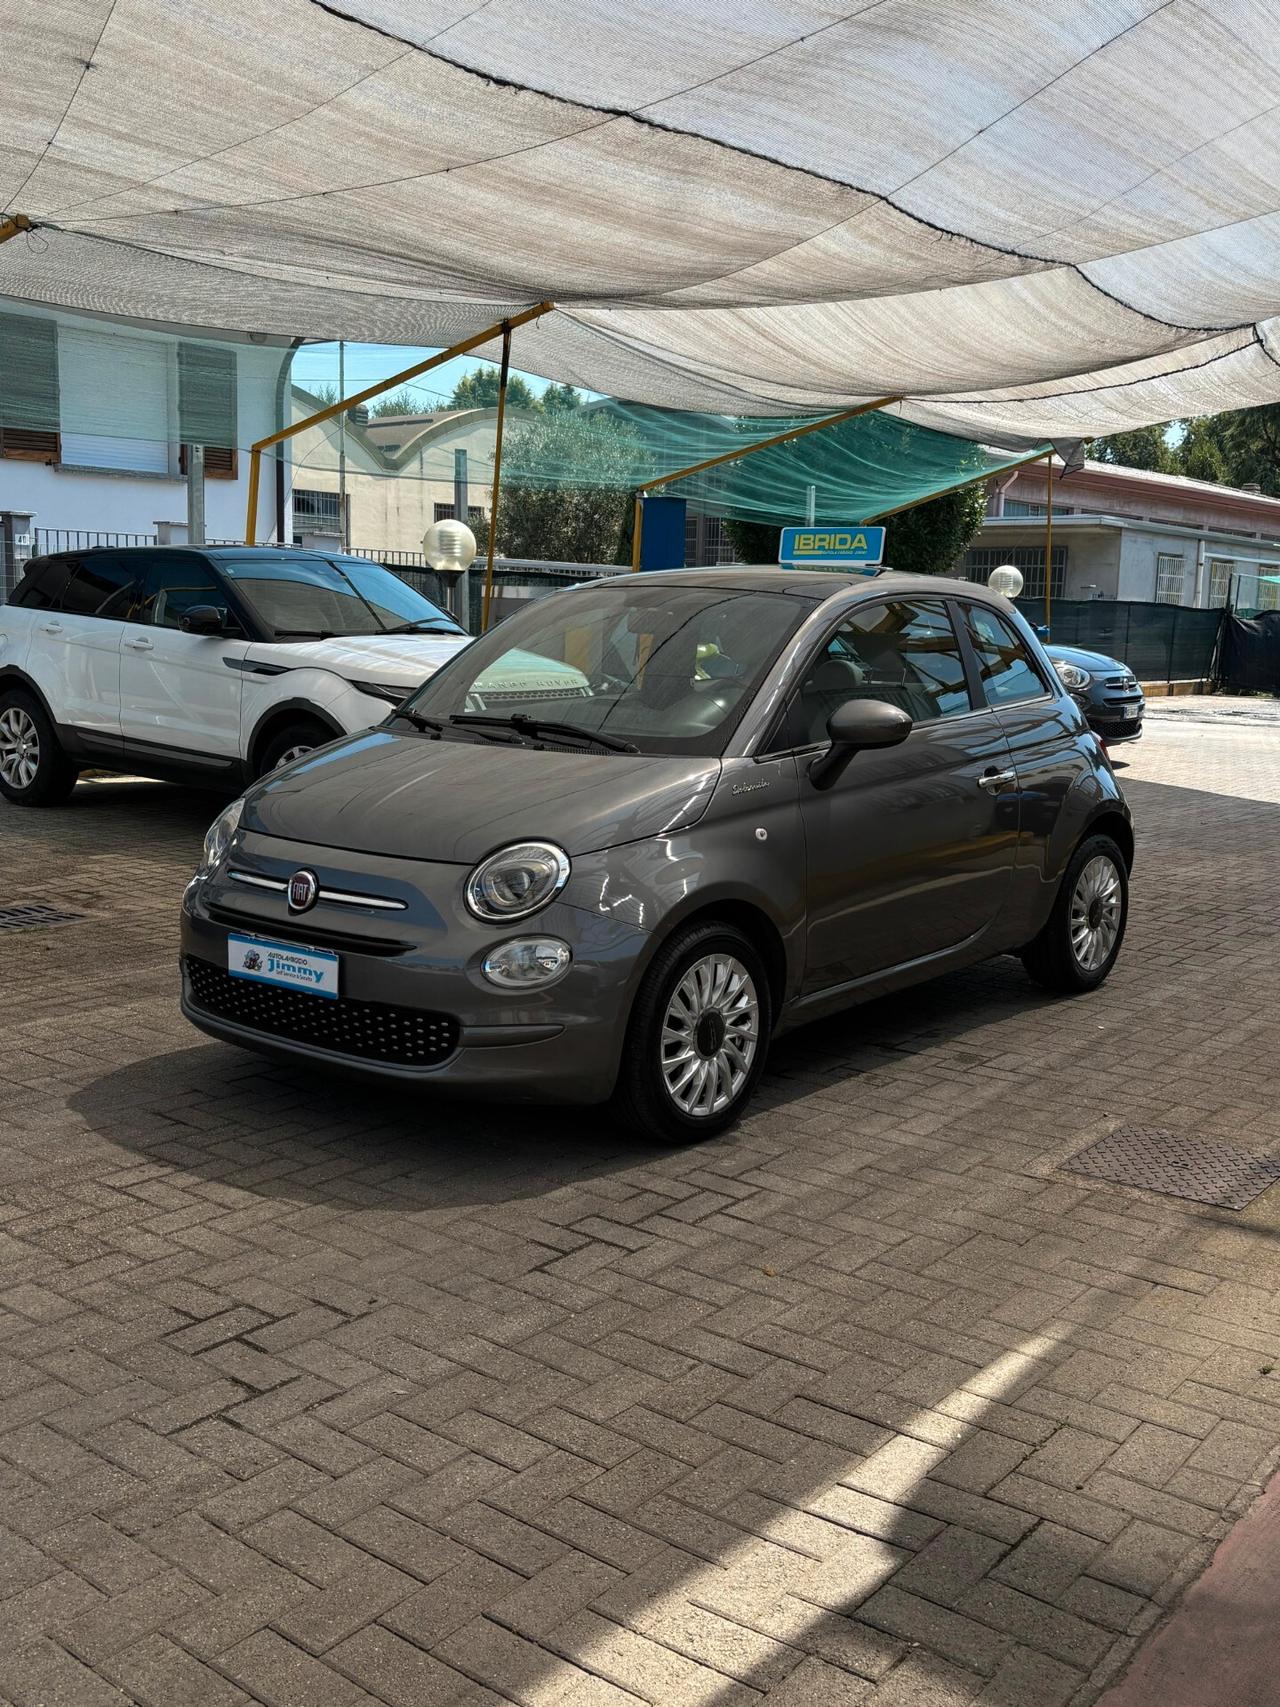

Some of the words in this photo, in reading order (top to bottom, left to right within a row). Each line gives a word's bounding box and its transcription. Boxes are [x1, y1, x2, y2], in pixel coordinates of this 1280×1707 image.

[794, 533, 868, 550] IBRIDA
[293, 882, 309, 901] FIAT
[267, 958, 325, 983] Jimmy
